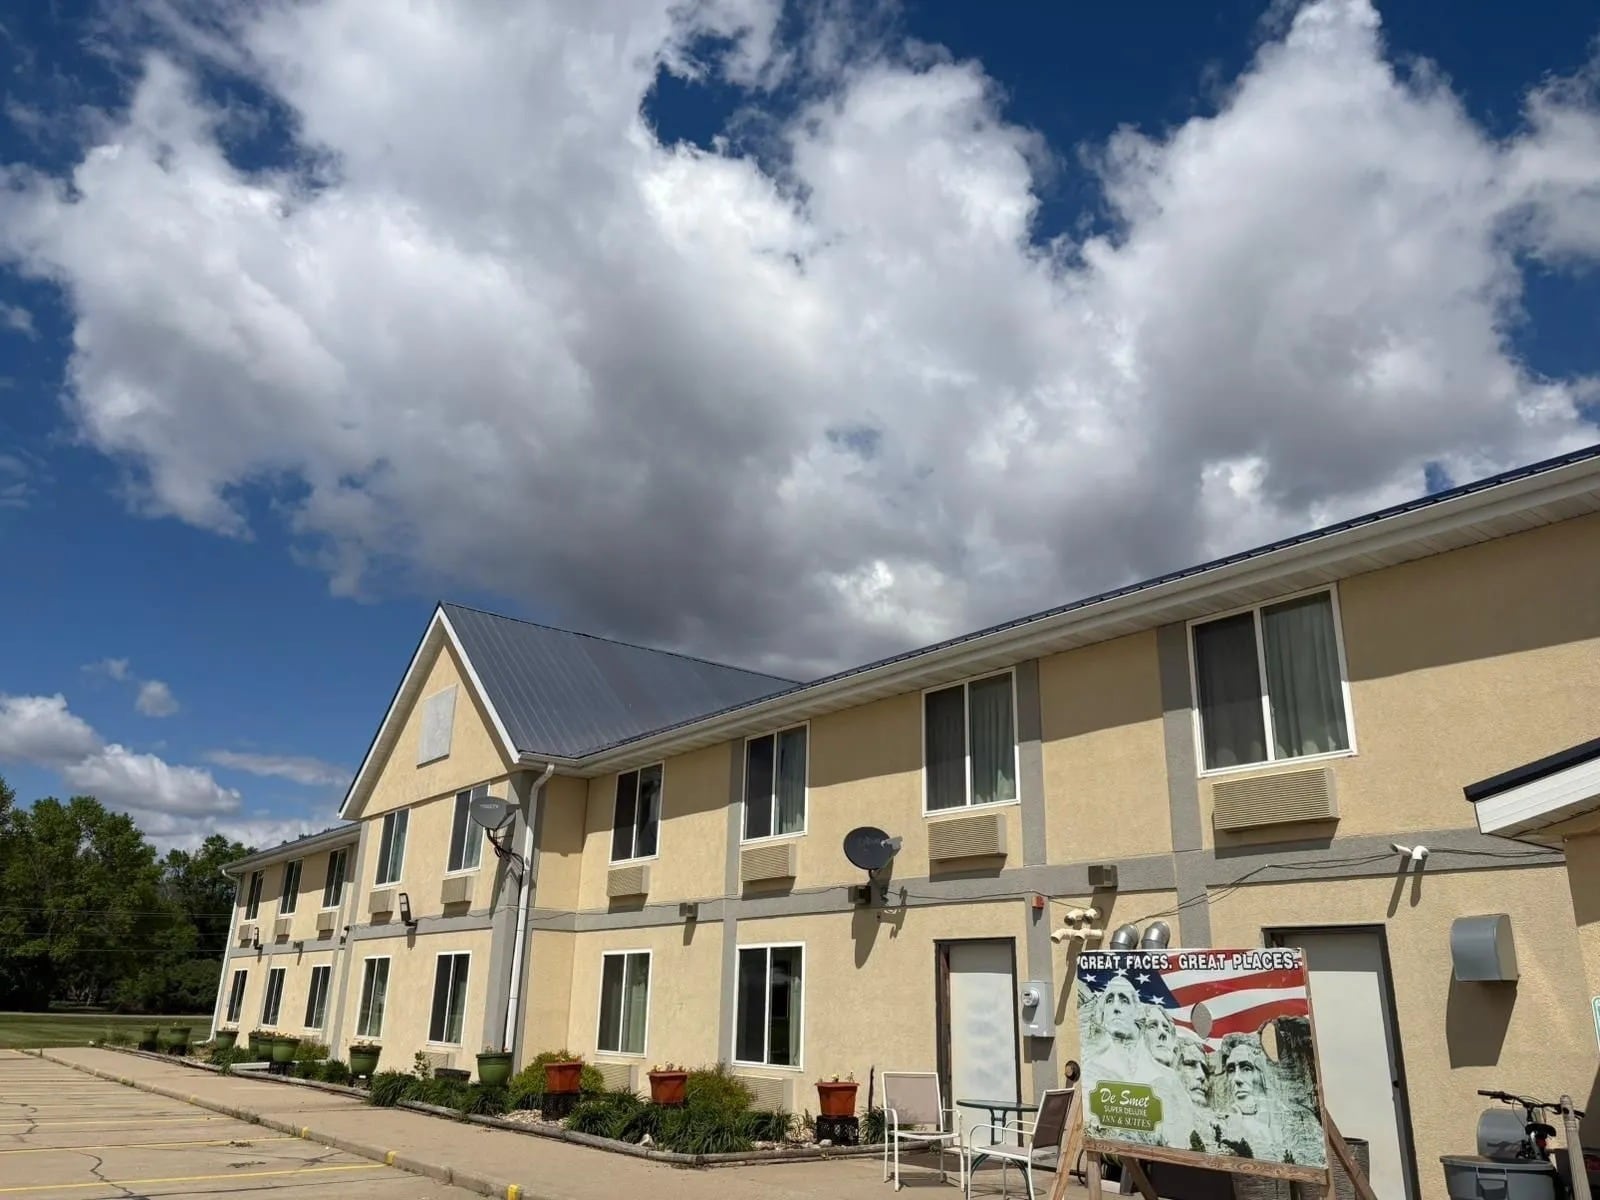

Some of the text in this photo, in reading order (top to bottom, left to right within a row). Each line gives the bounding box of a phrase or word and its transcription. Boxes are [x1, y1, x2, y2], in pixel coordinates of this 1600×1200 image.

[1080, 953, 1299, 971] GREAT FACES. GREAT PLACES.
[1100, 1088, 1150, 1107] De Smet
[1104, 1105, 1147, 1117] SUPER DELUXE
[1102, 1115, 1151, 1128] INN & SUITES
